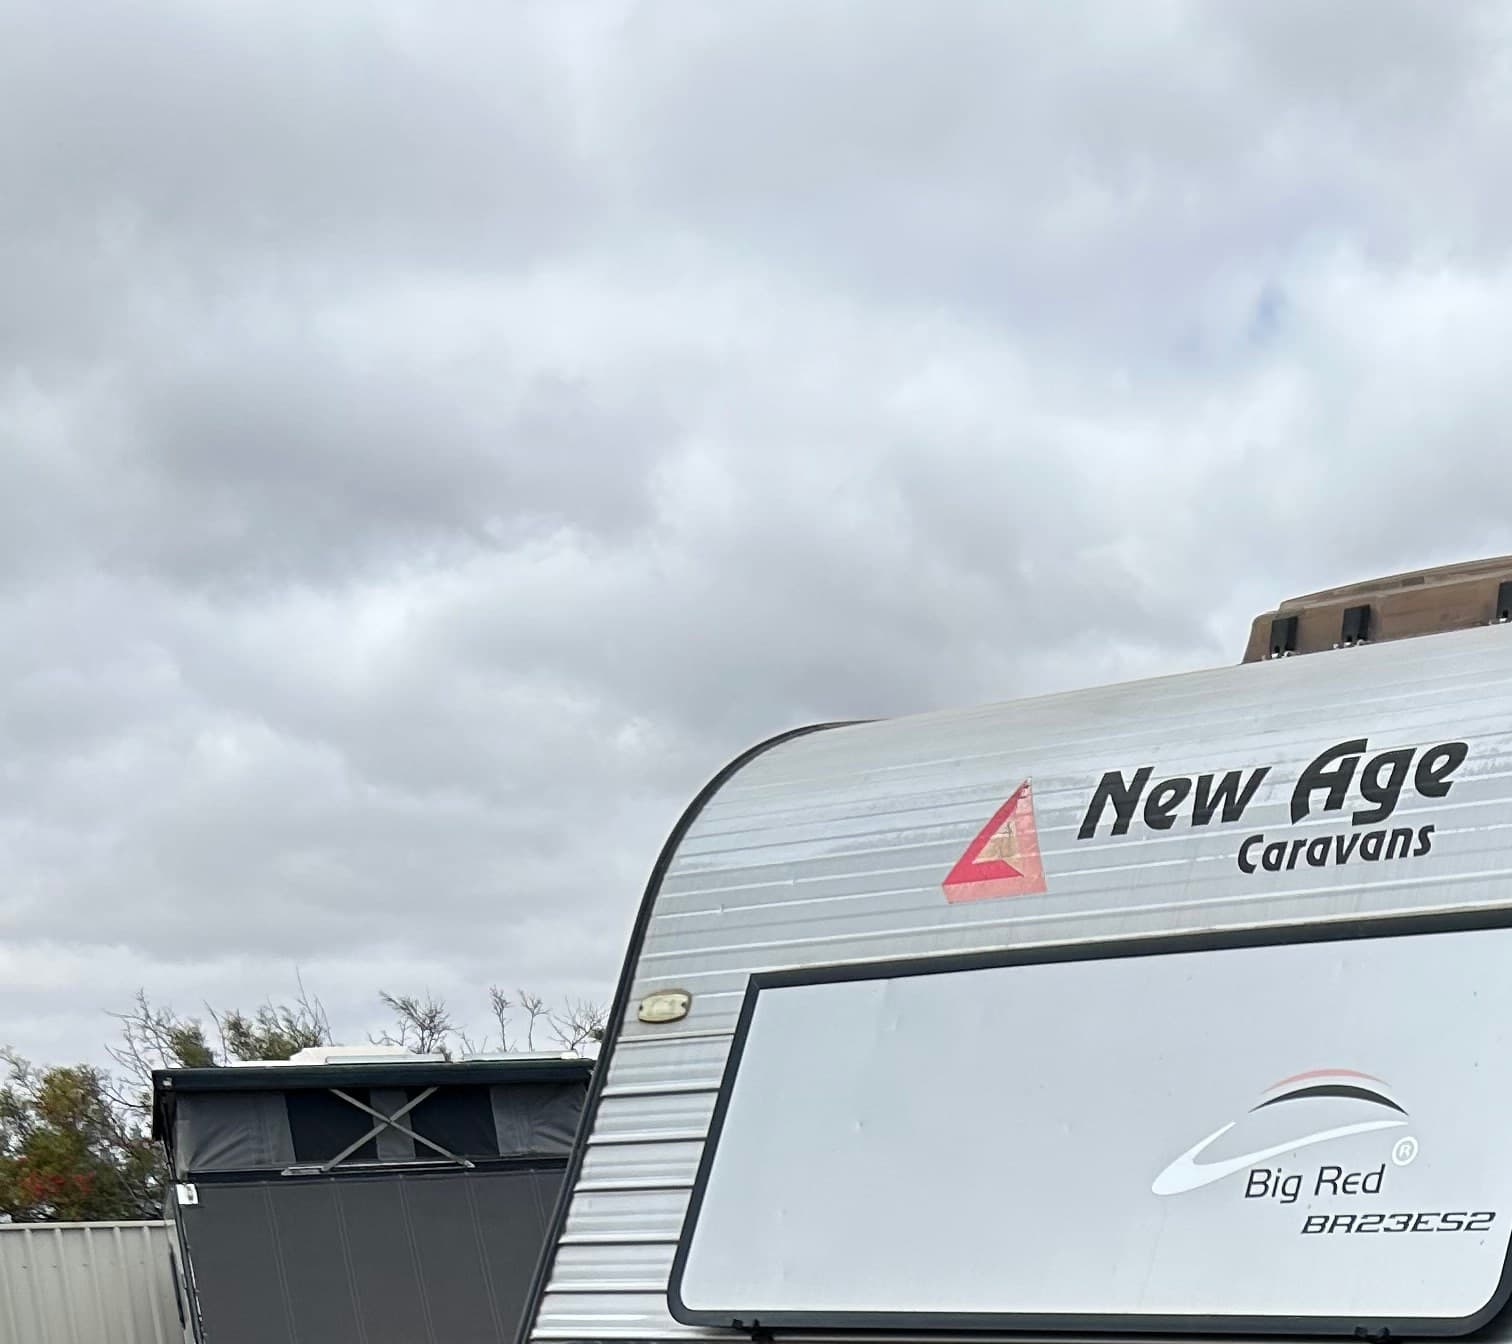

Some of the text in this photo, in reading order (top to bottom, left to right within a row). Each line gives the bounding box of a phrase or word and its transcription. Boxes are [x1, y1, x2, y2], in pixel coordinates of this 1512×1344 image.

[1077, 738, 1469, 840] New Age
[1237, 823, 1435, 874] Caravans
[1245, 1164, 1386, 1203] Big Red
[1300, 1212, 1496, 1235] BR23ES2
